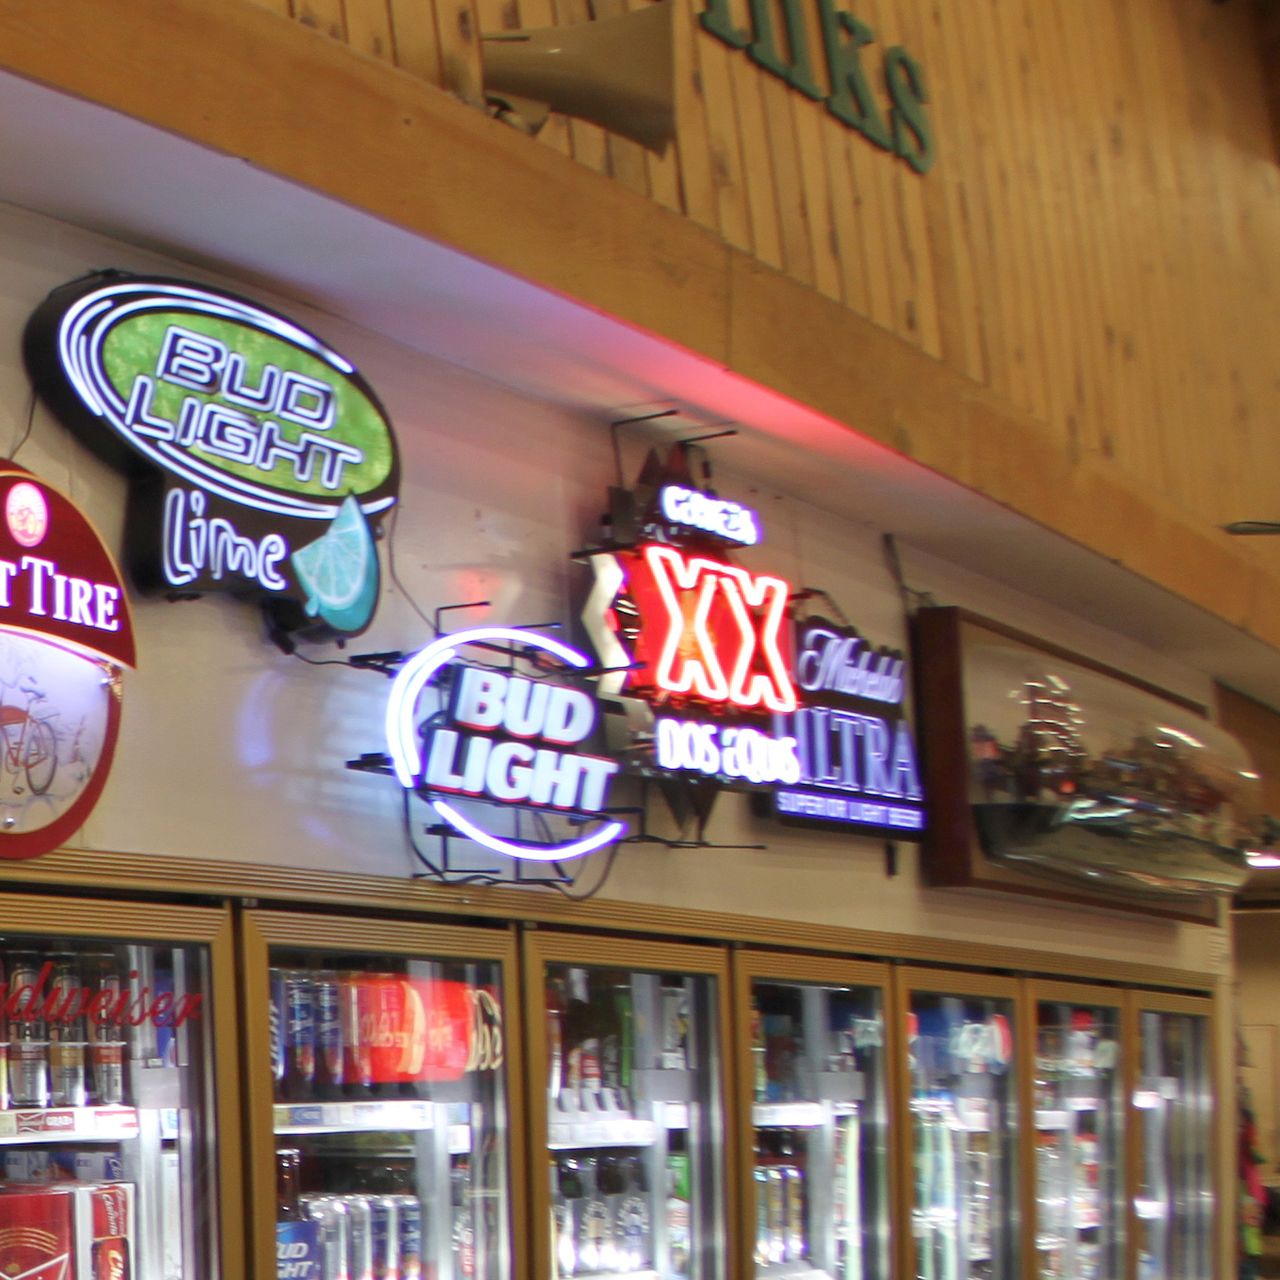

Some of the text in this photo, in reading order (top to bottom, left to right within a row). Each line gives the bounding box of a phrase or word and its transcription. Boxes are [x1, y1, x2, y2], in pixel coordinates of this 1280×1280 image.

[156, 324, 335, 431] BUD
[125, 374, 363, 491] LIGHT
[646, 546, 797, 713] XX
[453, 665, 596, 745] BUD
[657, 717, 718, 775] DOS
[423, 729, 619, 813] LIGHT
